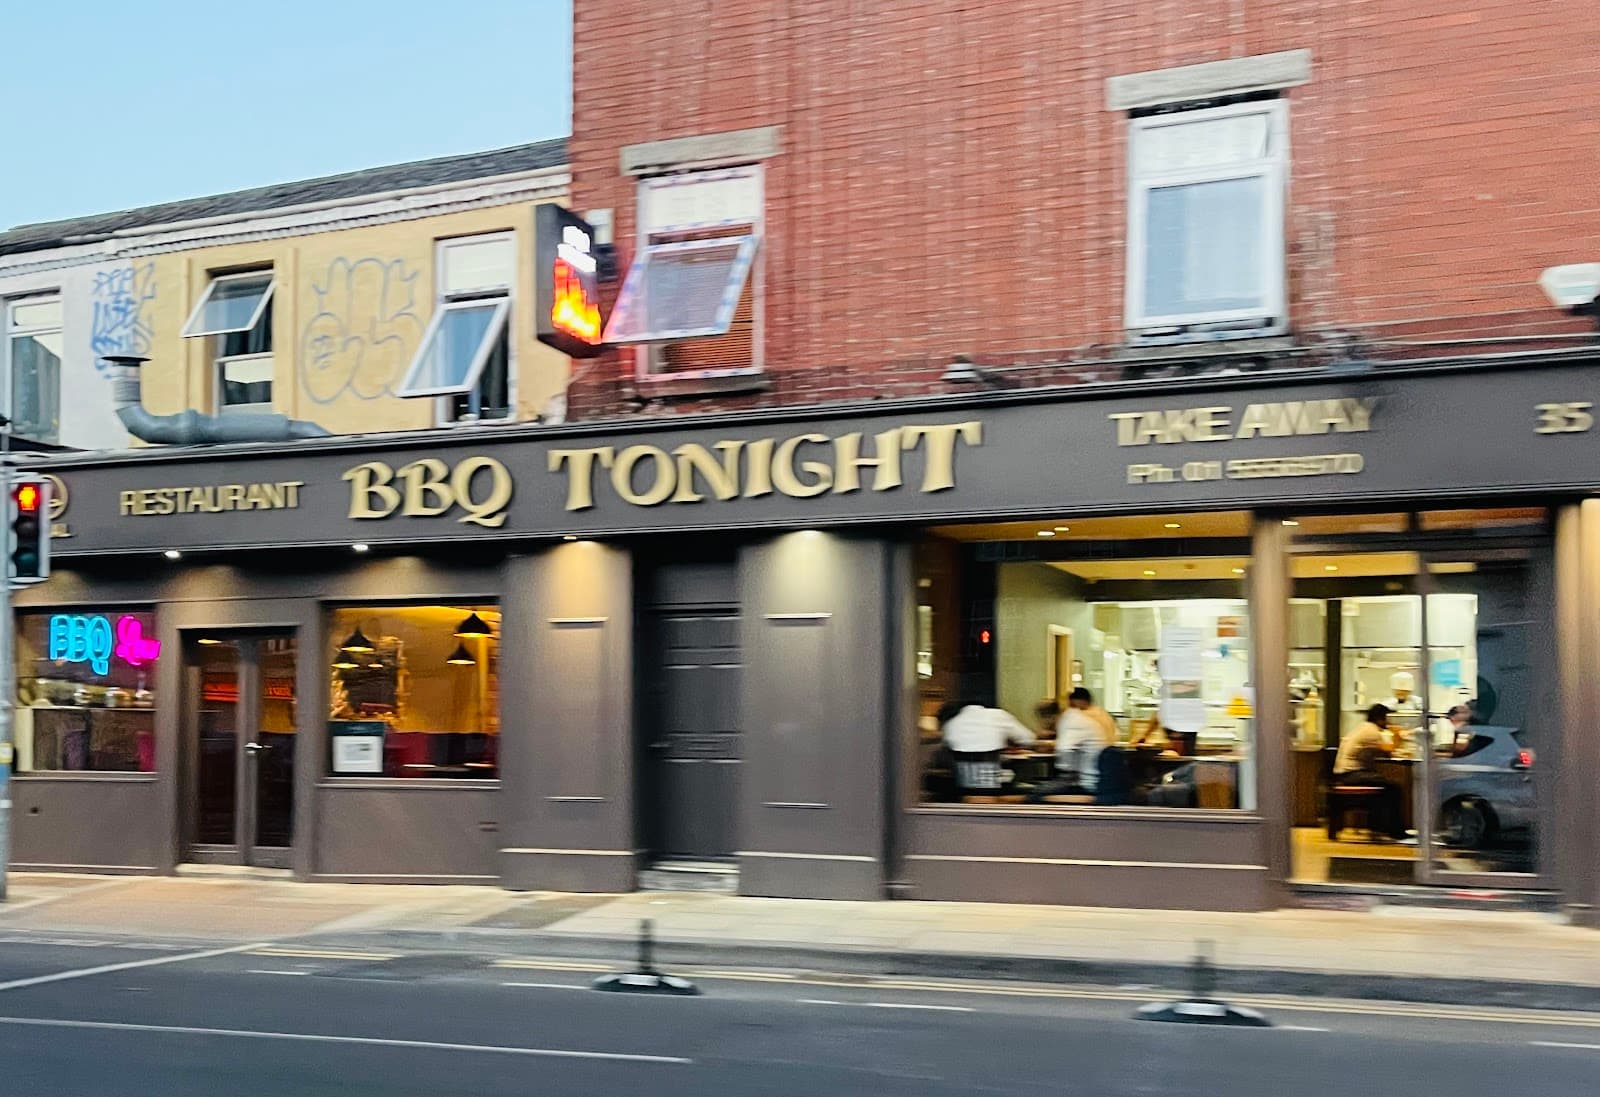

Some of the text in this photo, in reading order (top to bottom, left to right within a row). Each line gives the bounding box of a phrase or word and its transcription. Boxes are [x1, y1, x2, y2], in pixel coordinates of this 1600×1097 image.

[1108, 397, 1377, 447] TAKE AWAY
[1533, 402, 1594, 434] 35
[119, 481, 303, 516] RESTAURANT
[342, 421, 982, 528] BBQ TONIGHT
[49, 614, 113, 676] BBQ
